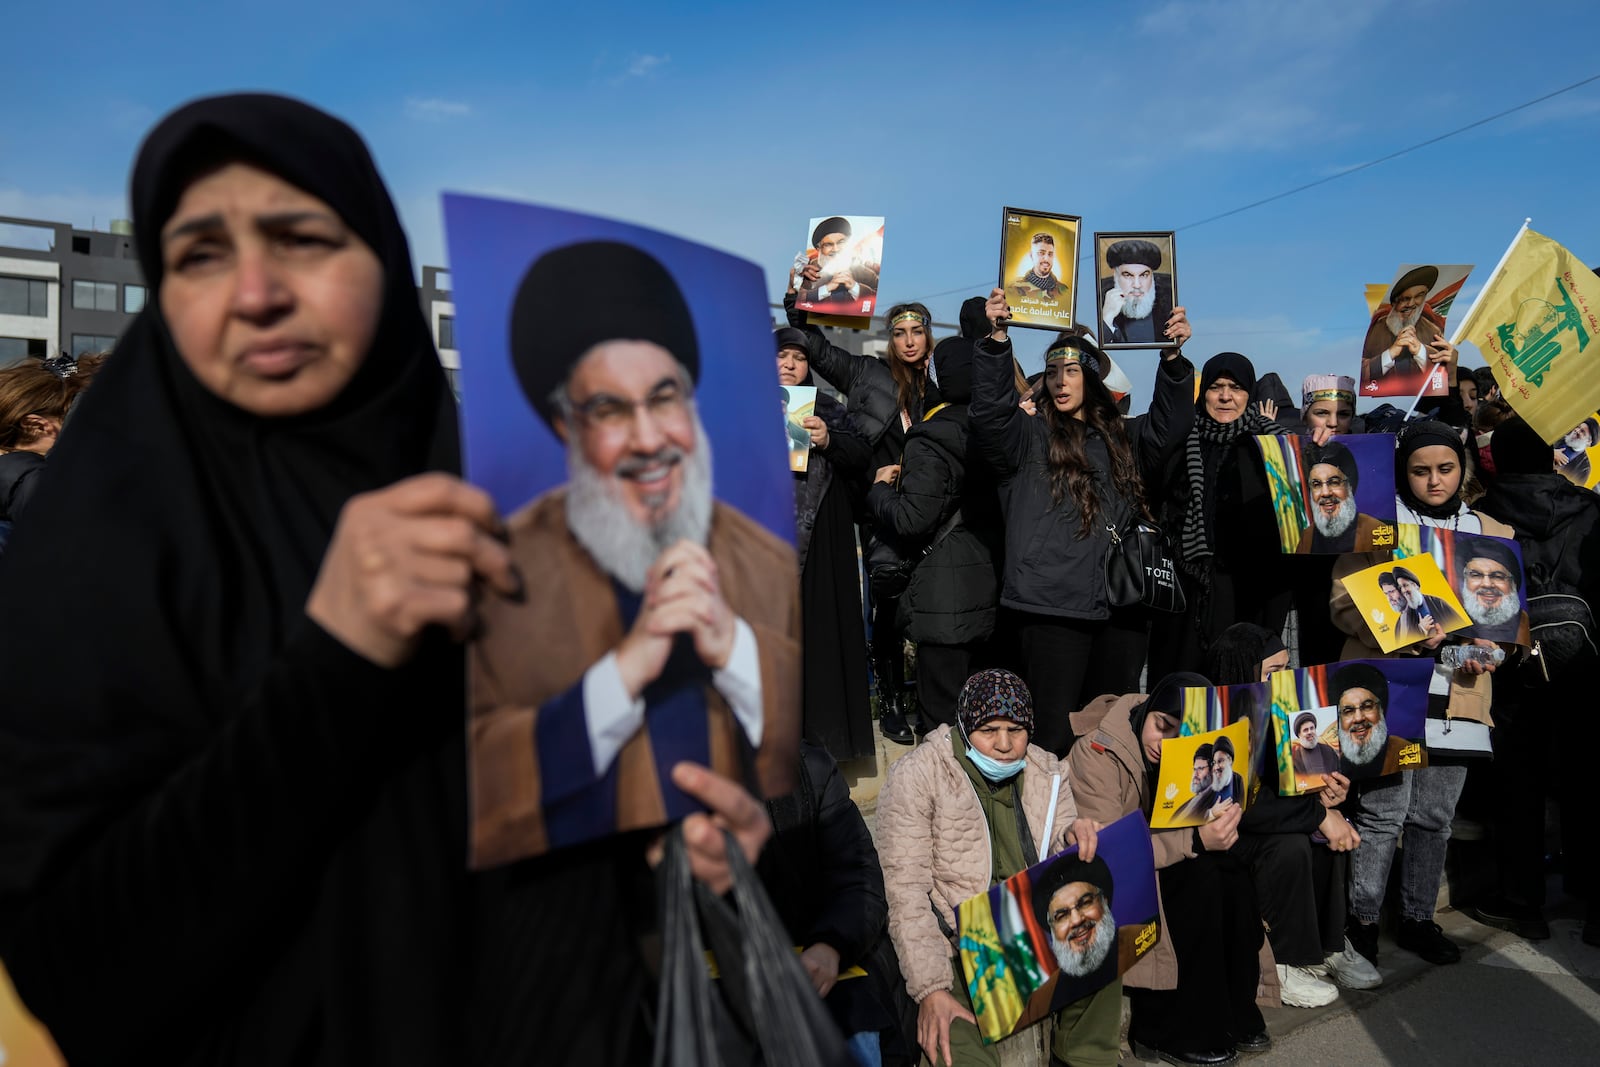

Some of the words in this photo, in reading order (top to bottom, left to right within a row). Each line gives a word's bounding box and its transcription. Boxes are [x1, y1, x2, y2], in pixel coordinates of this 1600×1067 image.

[1040, 299, 1059, 307] الشهيد
[1053, 309, 1070, 319] علي
[1145, 566, 1171, 581] TOTE
